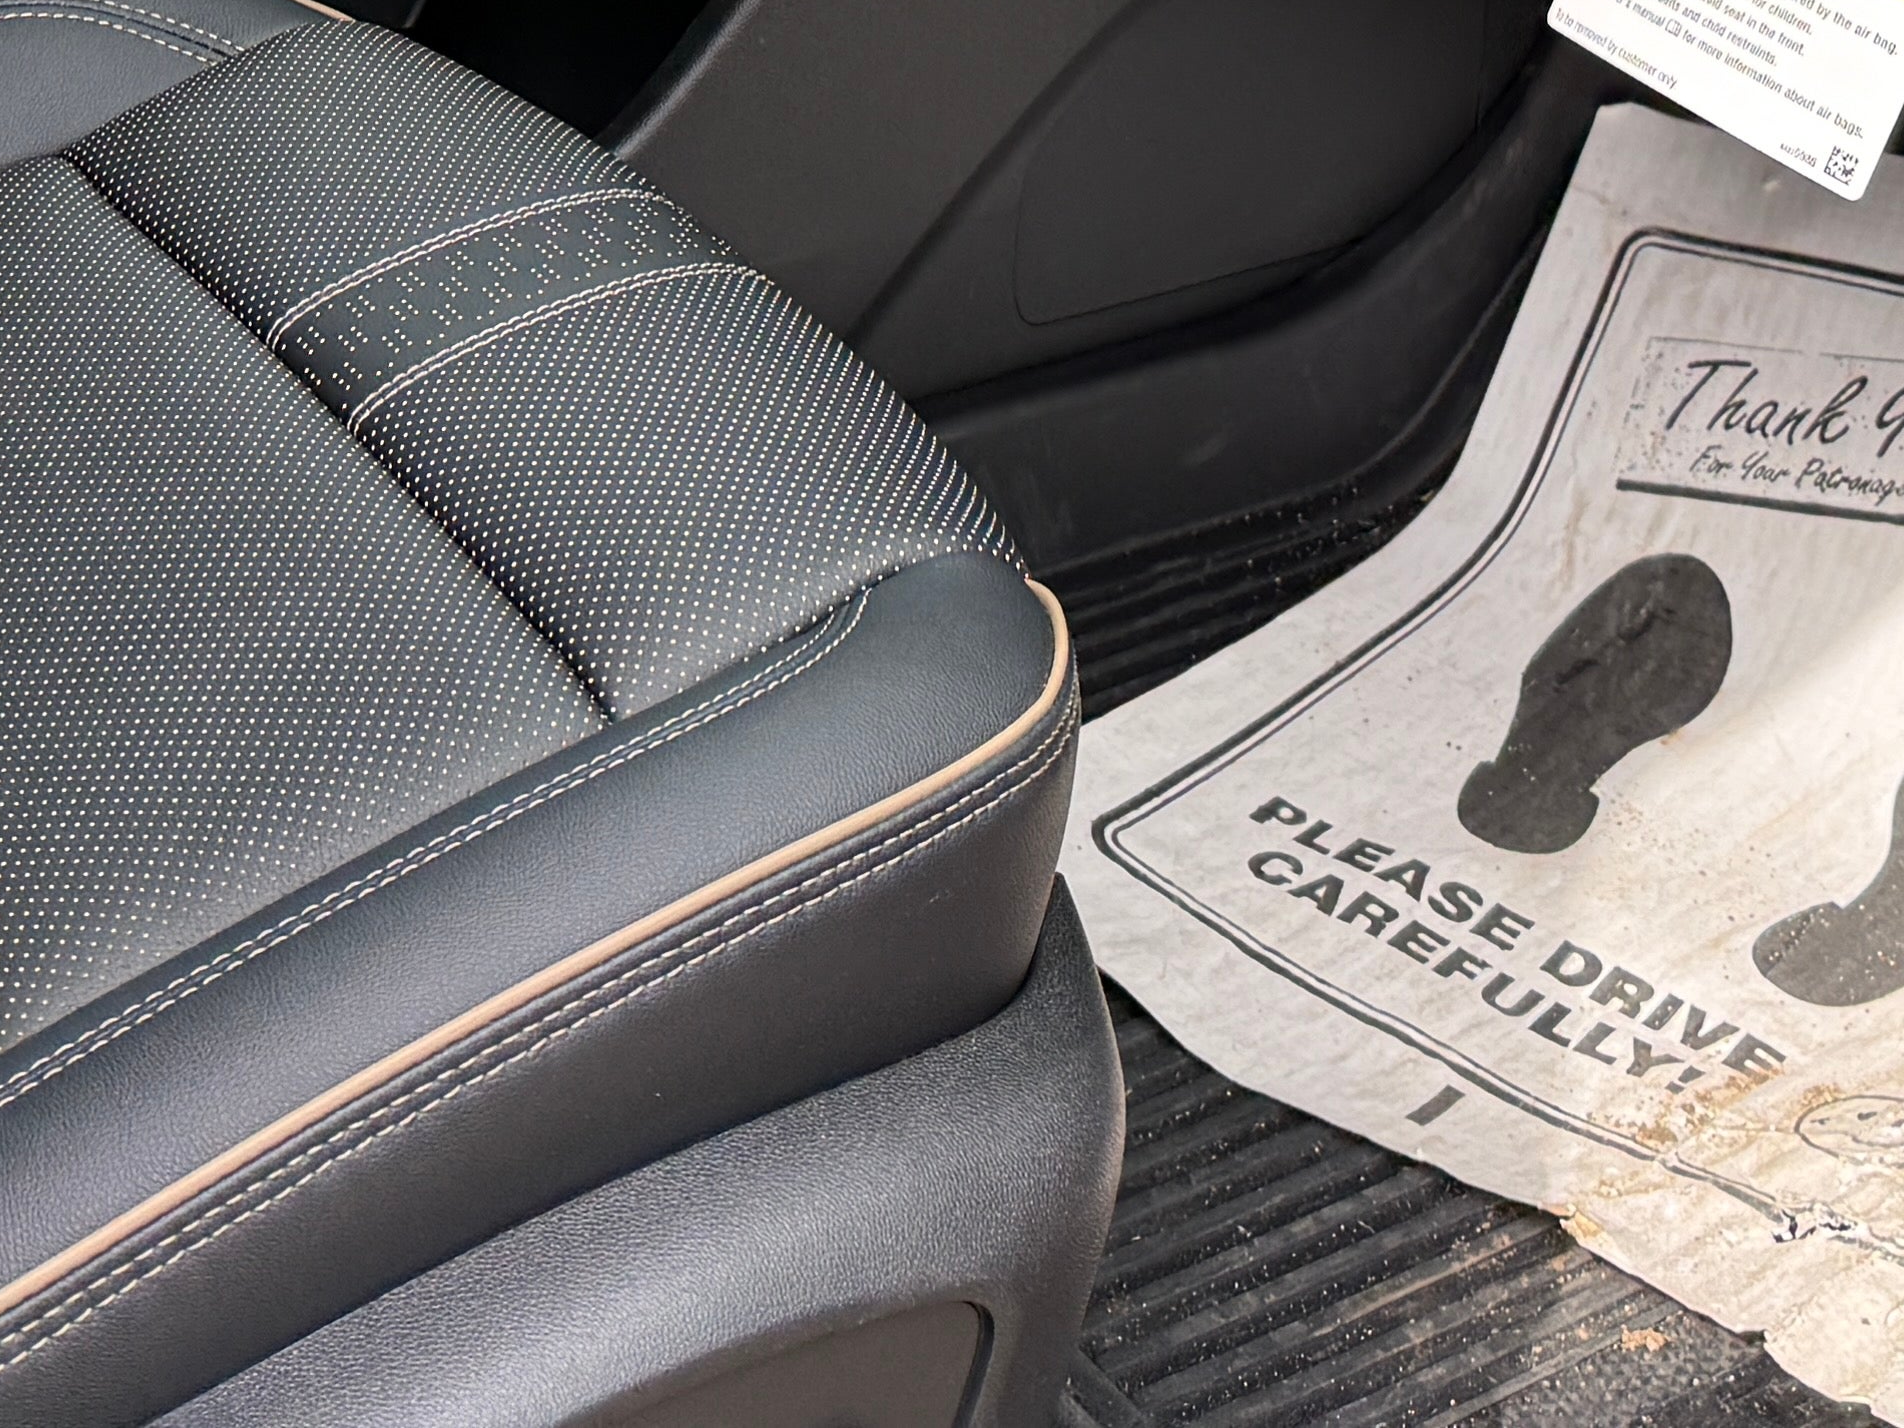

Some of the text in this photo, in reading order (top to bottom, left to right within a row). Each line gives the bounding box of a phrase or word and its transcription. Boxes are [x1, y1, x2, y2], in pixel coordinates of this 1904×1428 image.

[1723, 4, 1746, 23] seat
[1746, 15, 1757, 29] in
[1758, 22, 1776, 39] the
[1777, 32, 1804, 56] front.
[1768, 4, 1812, 36] children.
[1816, 2, 1832, 21] by
[1833, 11, 1853, 30] the
[1854, 25, 1871, 39] air
[1682, 29, 1697, 45] for
[1697, 40, 1723, 61] more
[1724, 52, 1783, 94] information
[1784, 88, 1816, 112] about
[1816, 106, 1832, 120] air
[1665, 358, 1869, 446] Thank
[1689, 443, 1734, 479] For
[1739, 451, 1791, 484] Your
[1248, 795, 1787, 1076] PLEASE DRIVE
[1247, 850, 1707, 1096] CAREFULLY!
